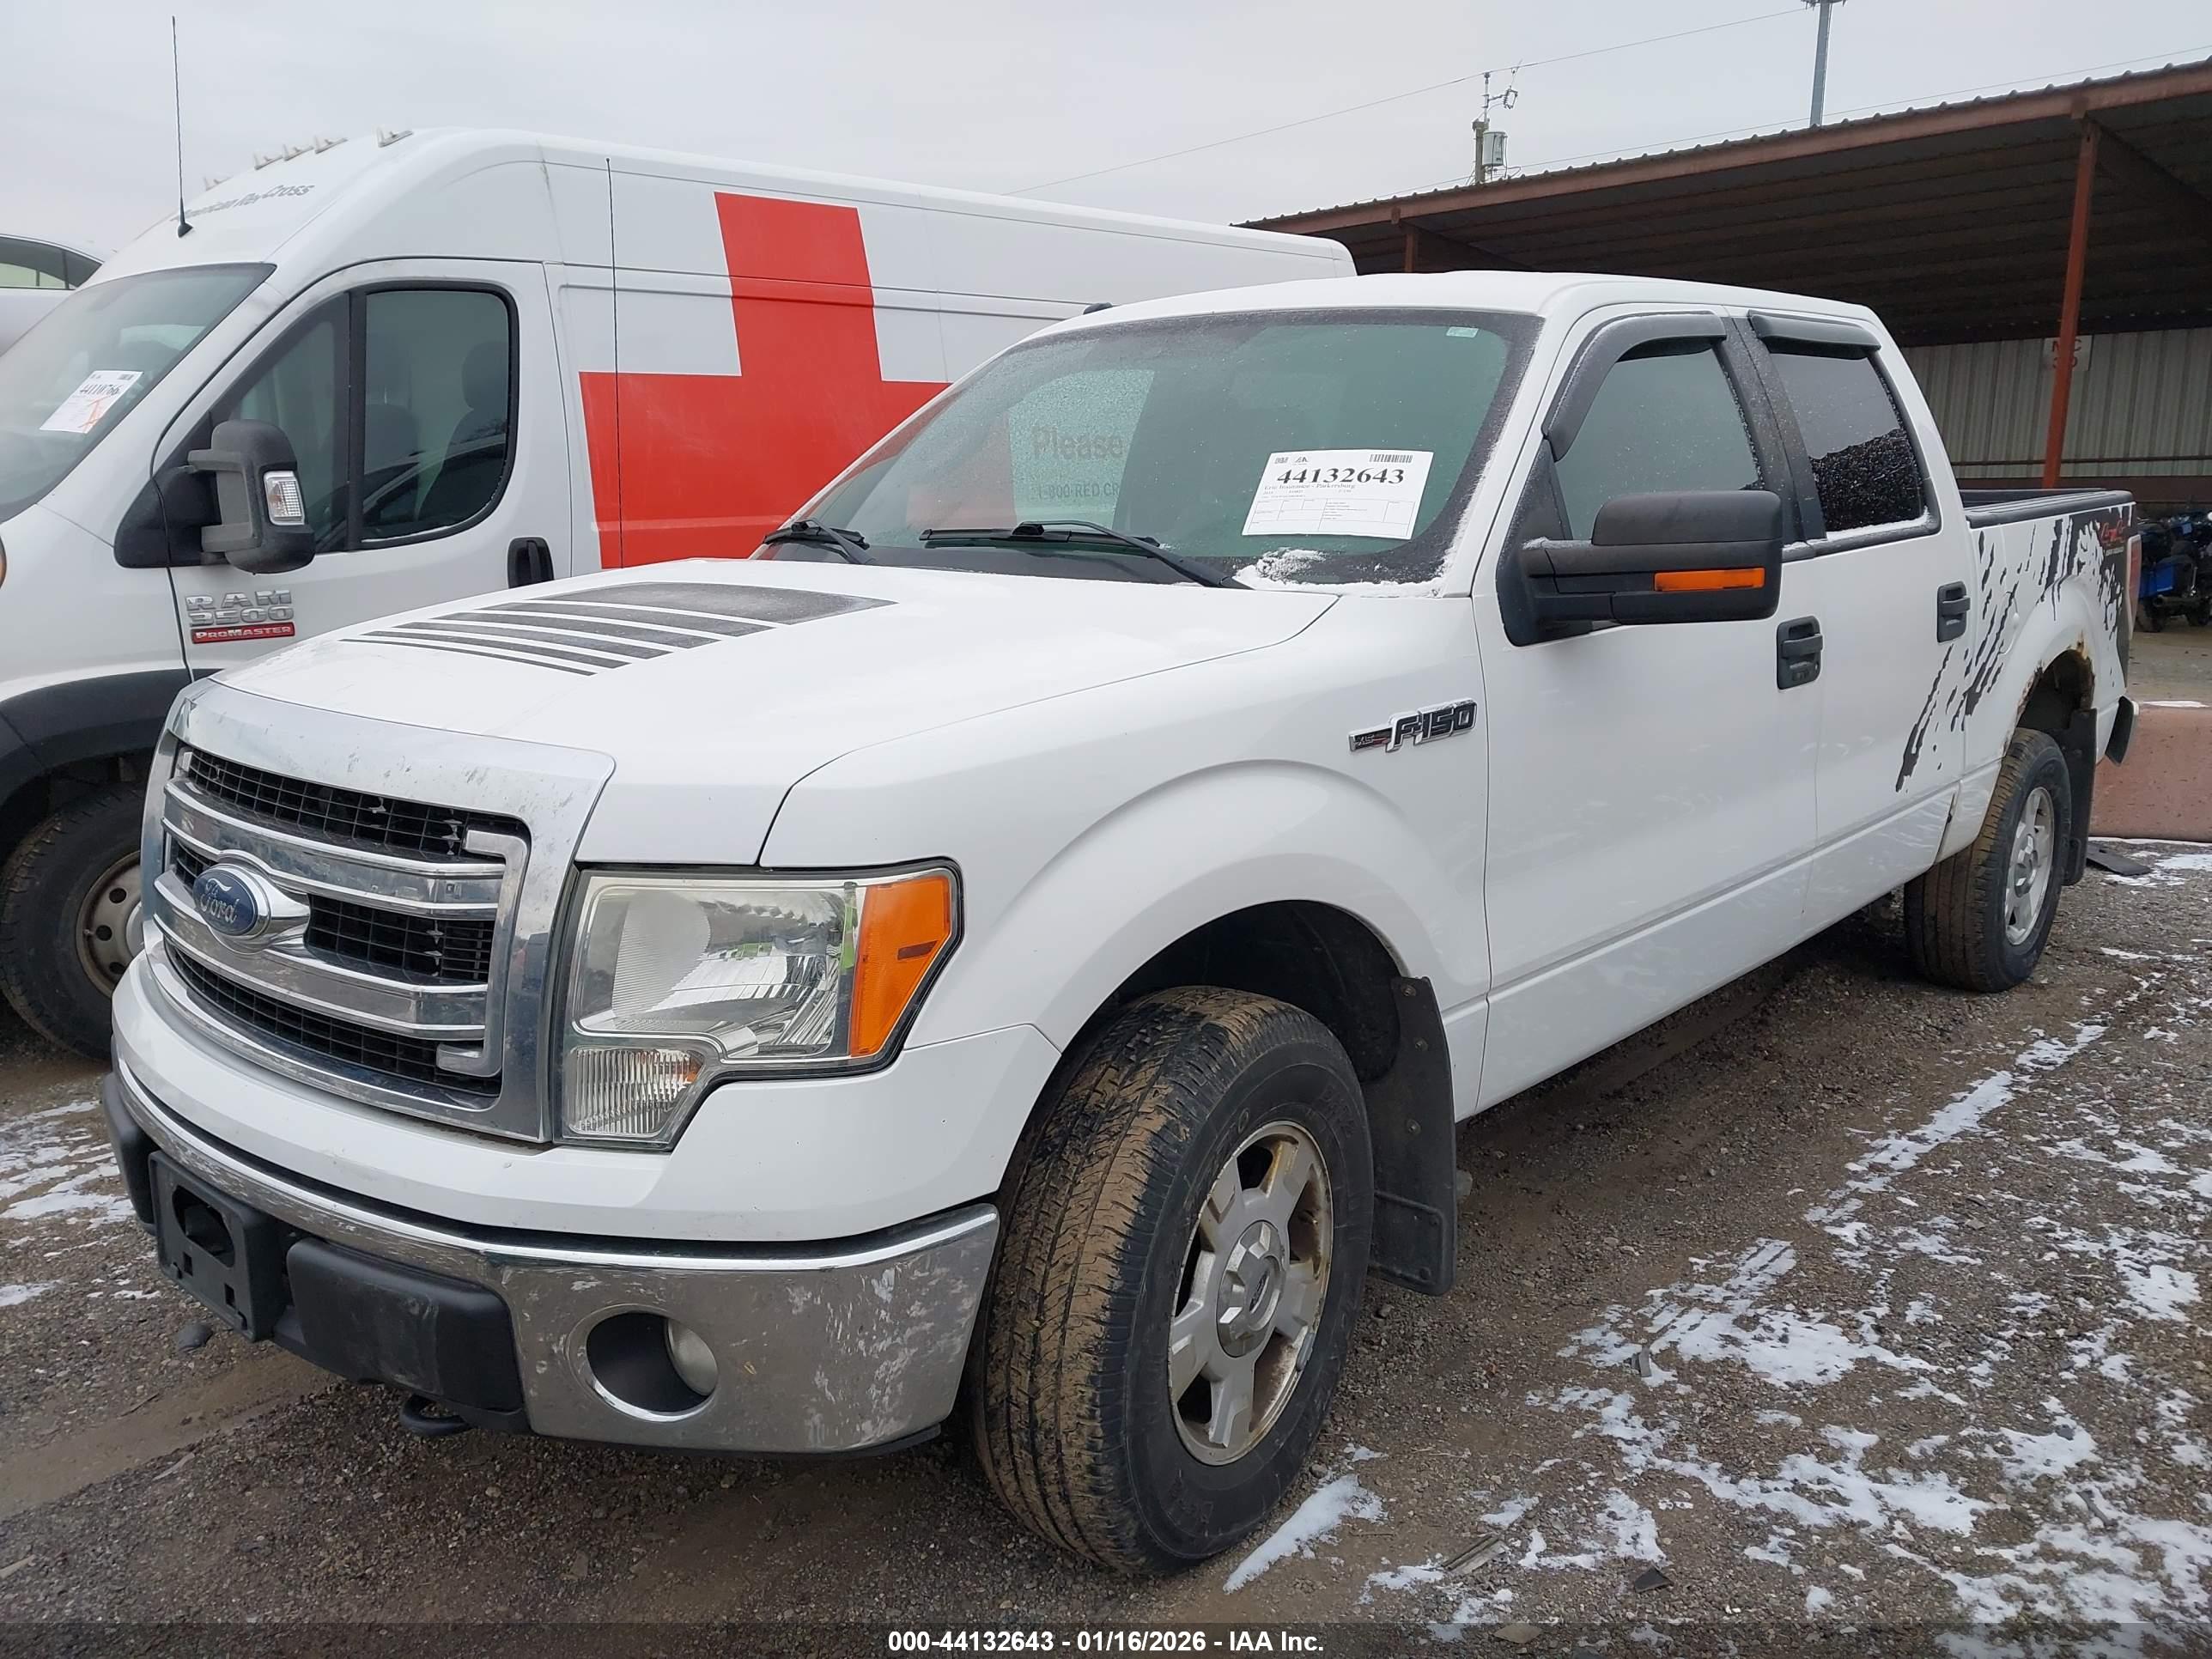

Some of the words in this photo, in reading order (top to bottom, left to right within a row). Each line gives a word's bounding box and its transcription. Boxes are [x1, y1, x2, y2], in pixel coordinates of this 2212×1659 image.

[262, 185, 315, 199] Cross
[1031, 425, 1122, 460] Please
[1277, 467, 1405, 484] 44132643
[185, 589, 292, 611] RAM
[189, 605, 295, 628] 3500
[200, 878, 240, 924] Ford
